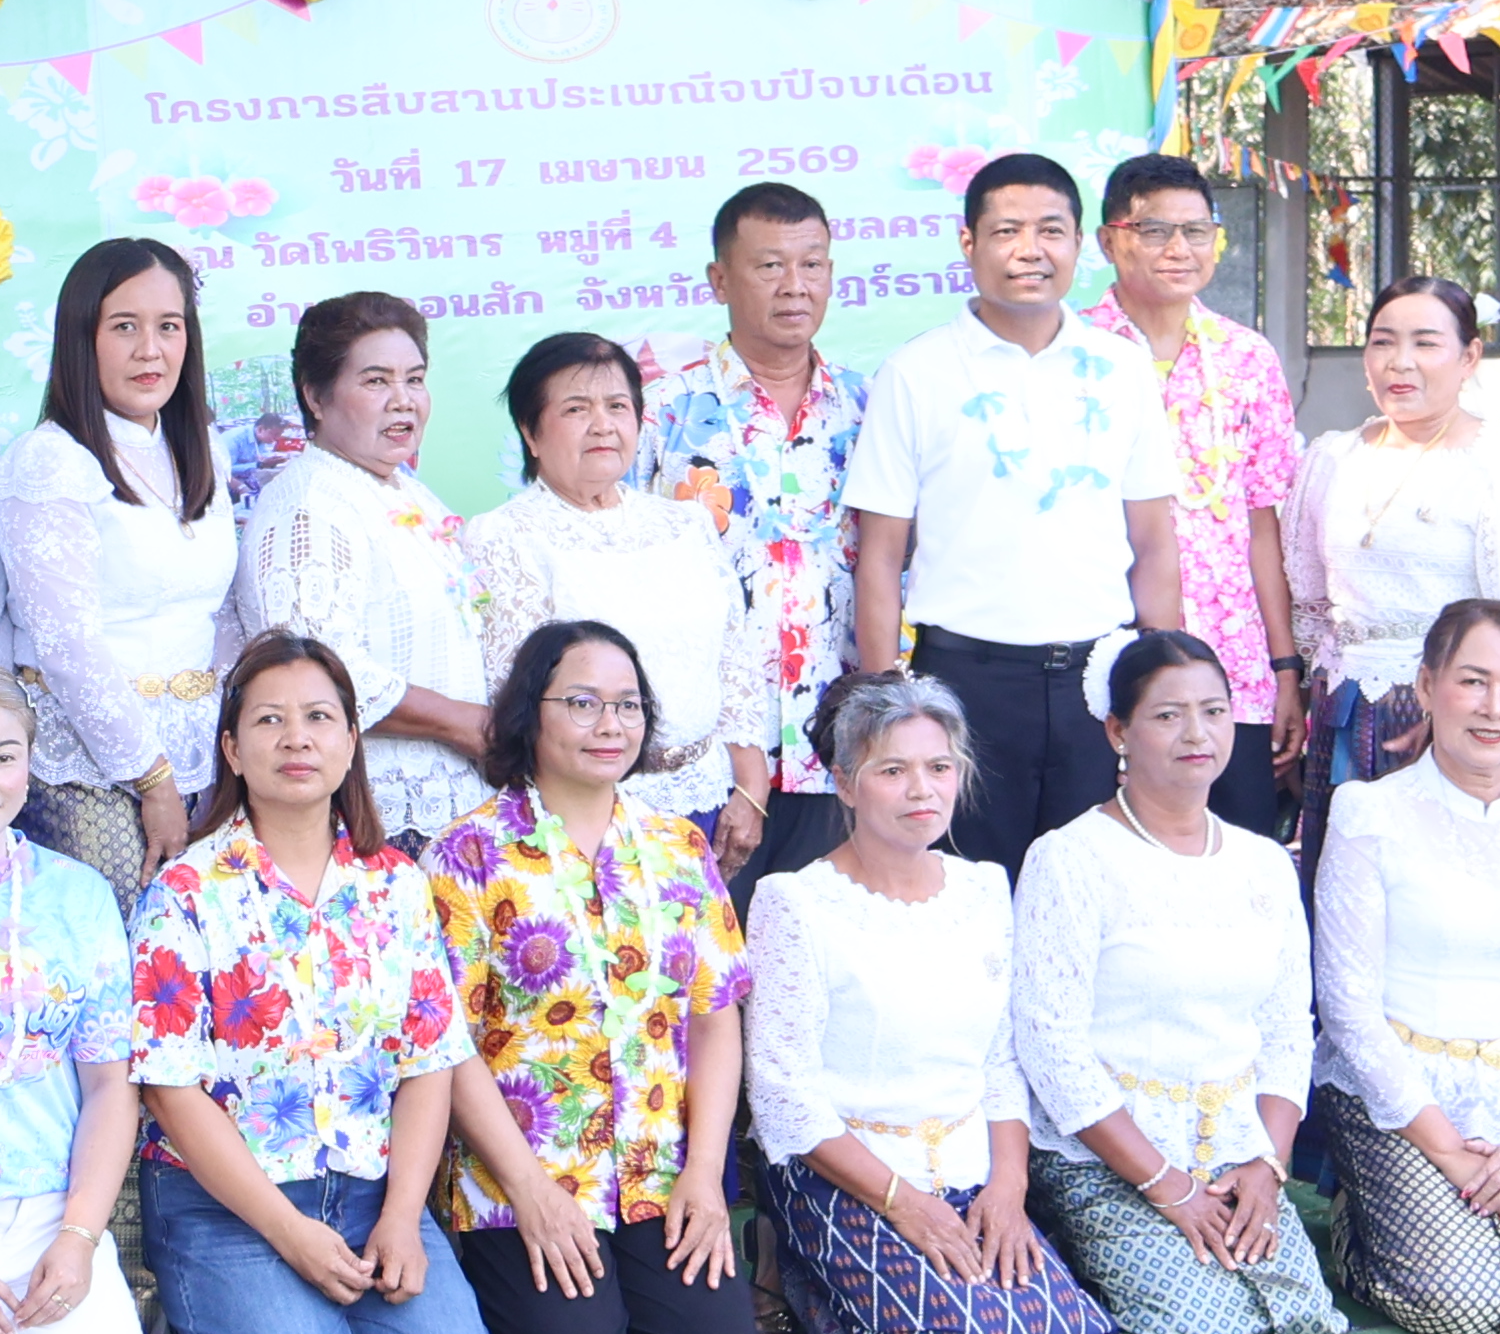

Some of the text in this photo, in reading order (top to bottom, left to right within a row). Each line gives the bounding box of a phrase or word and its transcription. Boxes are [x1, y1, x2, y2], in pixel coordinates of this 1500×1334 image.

[144, 65, 993, 124] โครงการสืบสานประเพณีจบปีจบเดือน
[330, 144, 859, 193] วันที่ 17 เมษายน 2569
[251, 226, 503, 267] วัดโพธิวิหาร
[537, 210, 632, 266] หมู่ที่
[649, 221, 678, 249] 4
